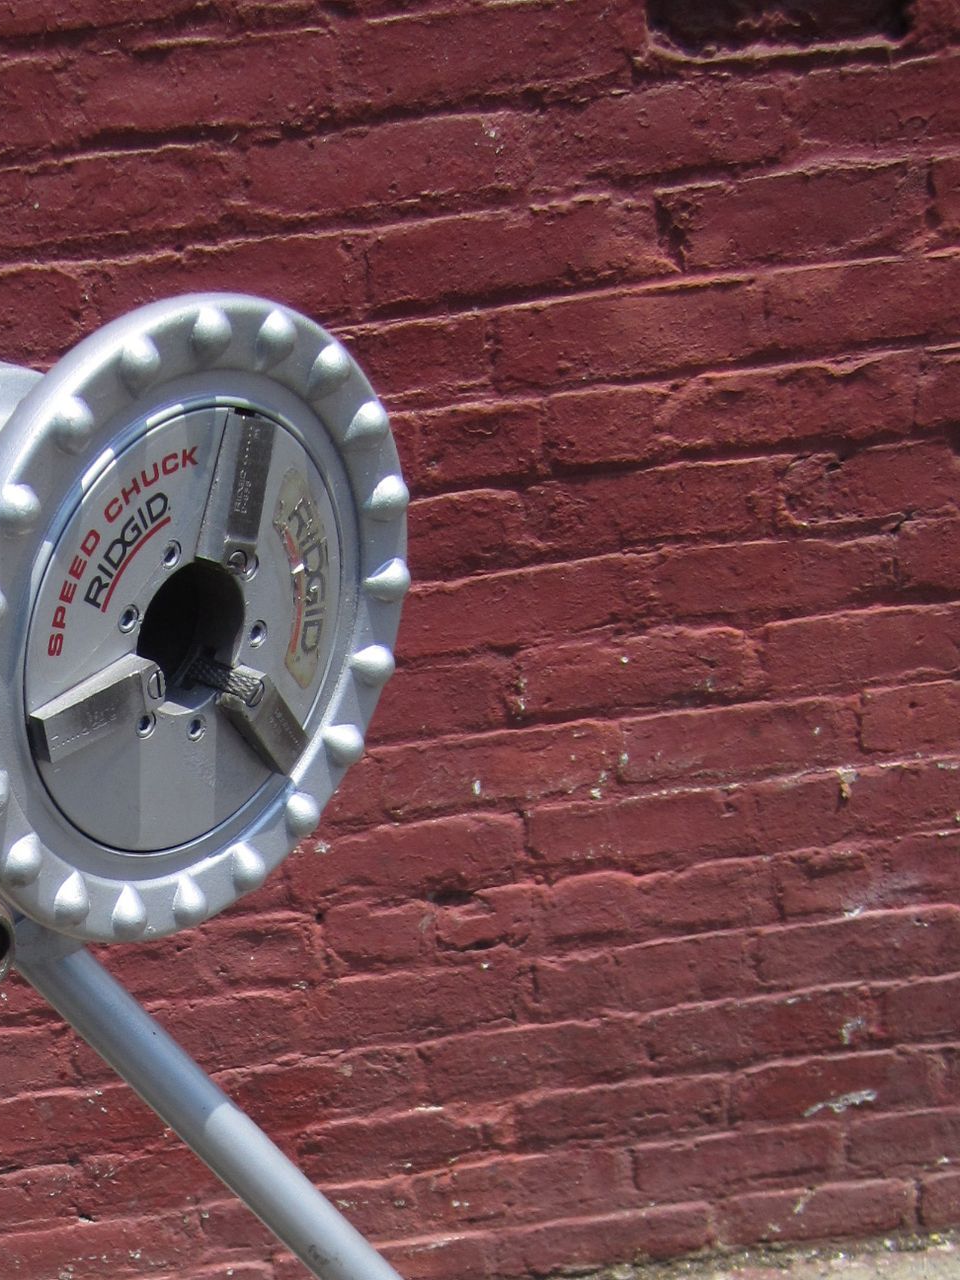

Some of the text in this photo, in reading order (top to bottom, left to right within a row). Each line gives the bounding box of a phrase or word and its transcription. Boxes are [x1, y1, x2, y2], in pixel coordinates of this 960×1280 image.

[47, 528, 101, 657] SPEED
[103, 446, 199, 524] CHUCK
[83, 491, 171, 609] RIDGID
[286, 498, 329, 656] RIDGID
